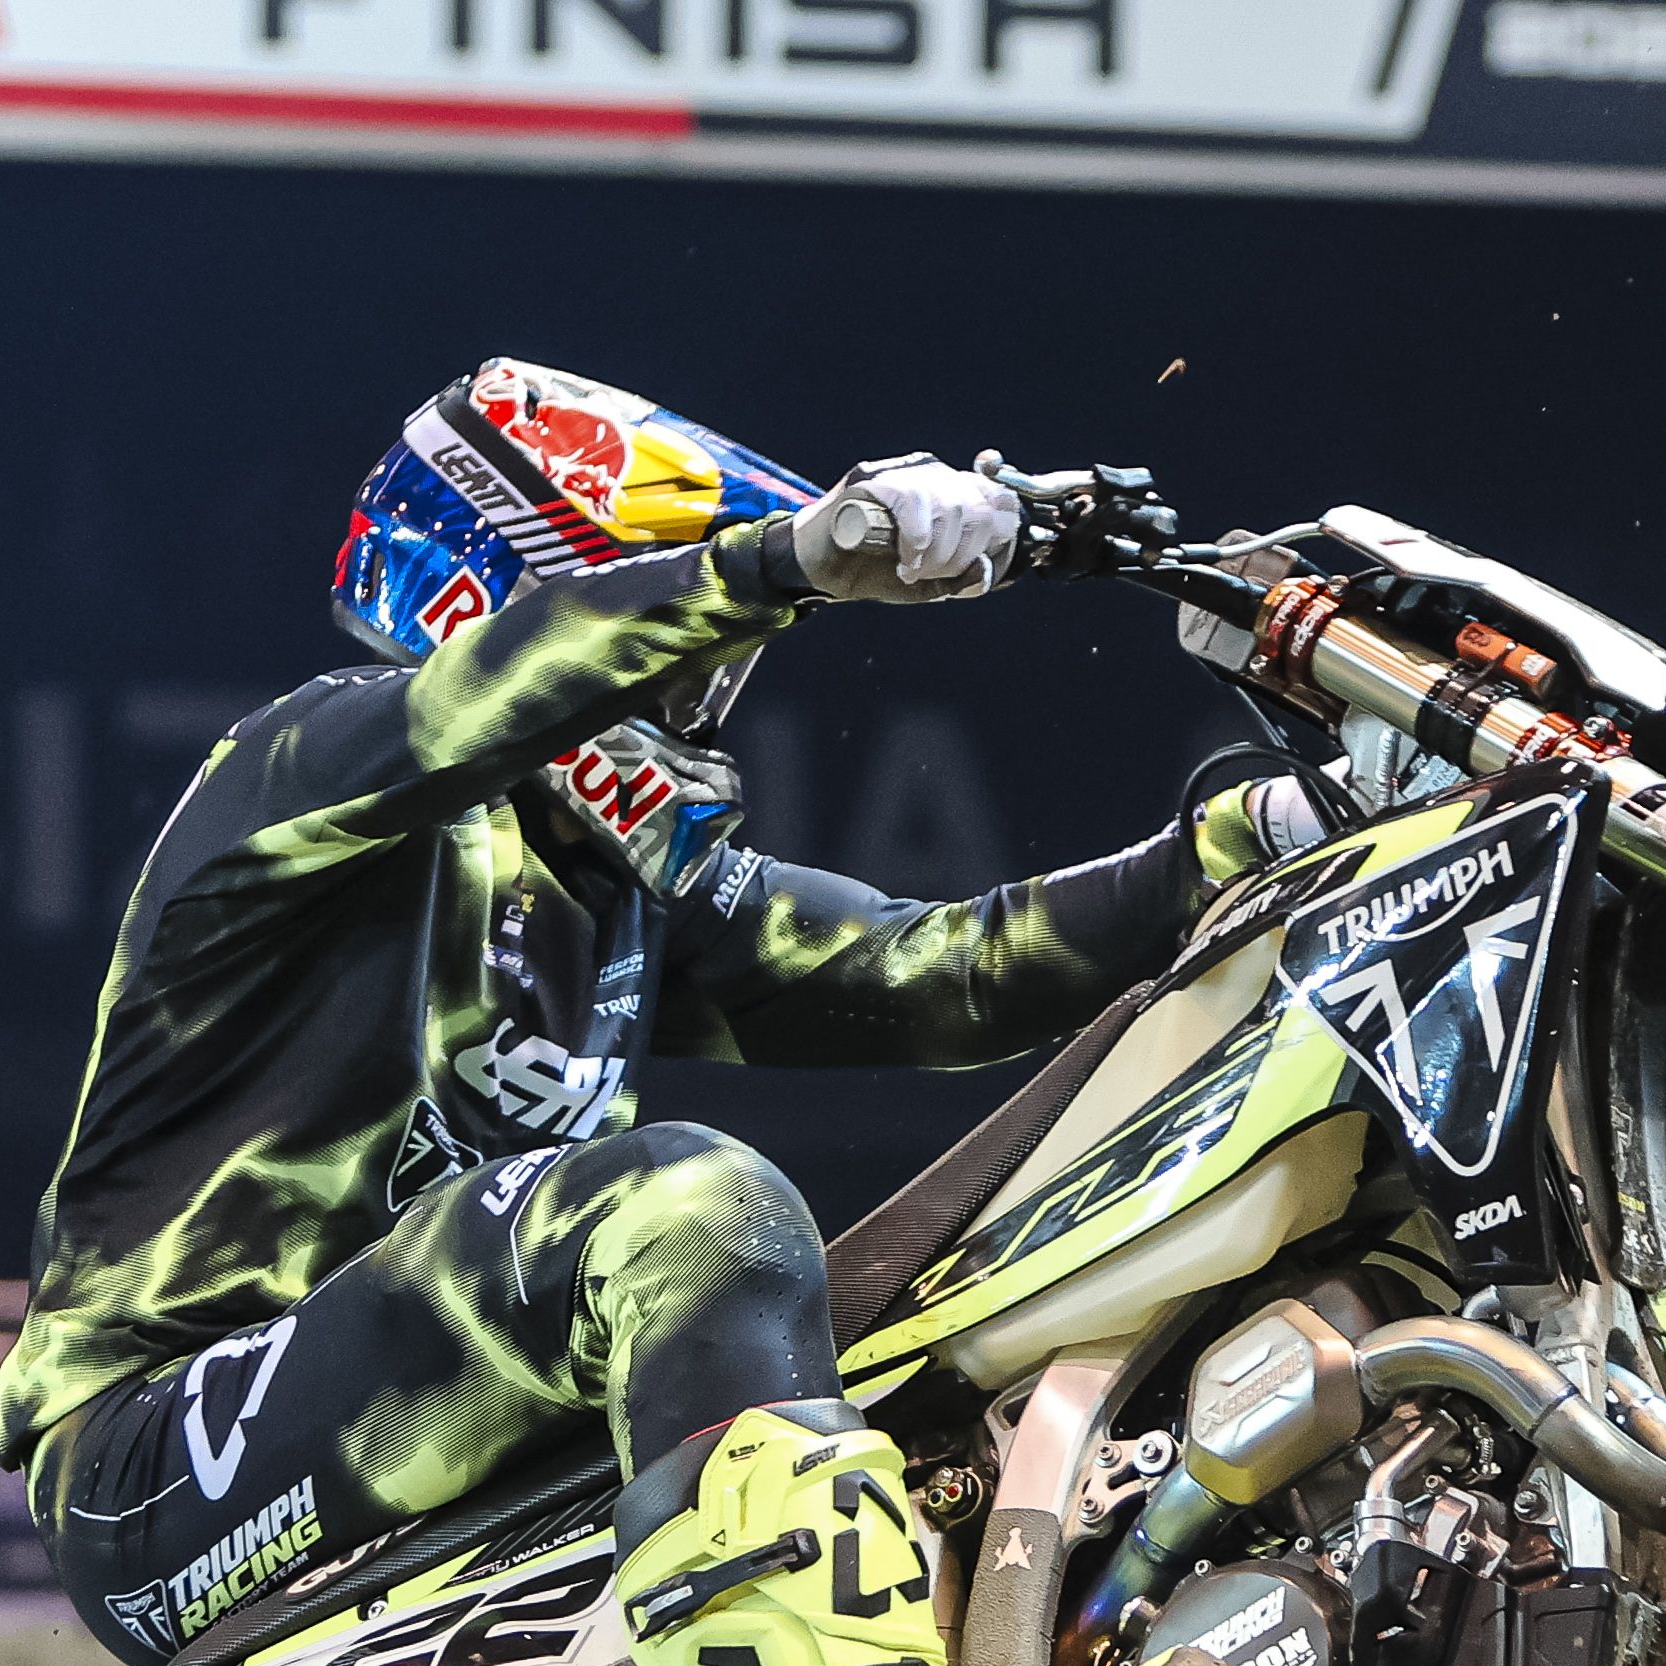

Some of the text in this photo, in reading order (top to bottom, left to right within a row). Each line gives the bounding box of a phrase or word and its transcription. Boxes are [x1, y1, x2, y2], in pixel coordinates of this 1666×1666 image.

[422, 573, 484, 641] R
[1318, 839, 1515, 955] TRIUMPH
[593, 993, 643, 1019] TRIU
[168, 1474, 317, 1609] TRIUMPH
[179, 1510, 323, 1640] RACING
[512, 1522, 595, 1565] WALKER
